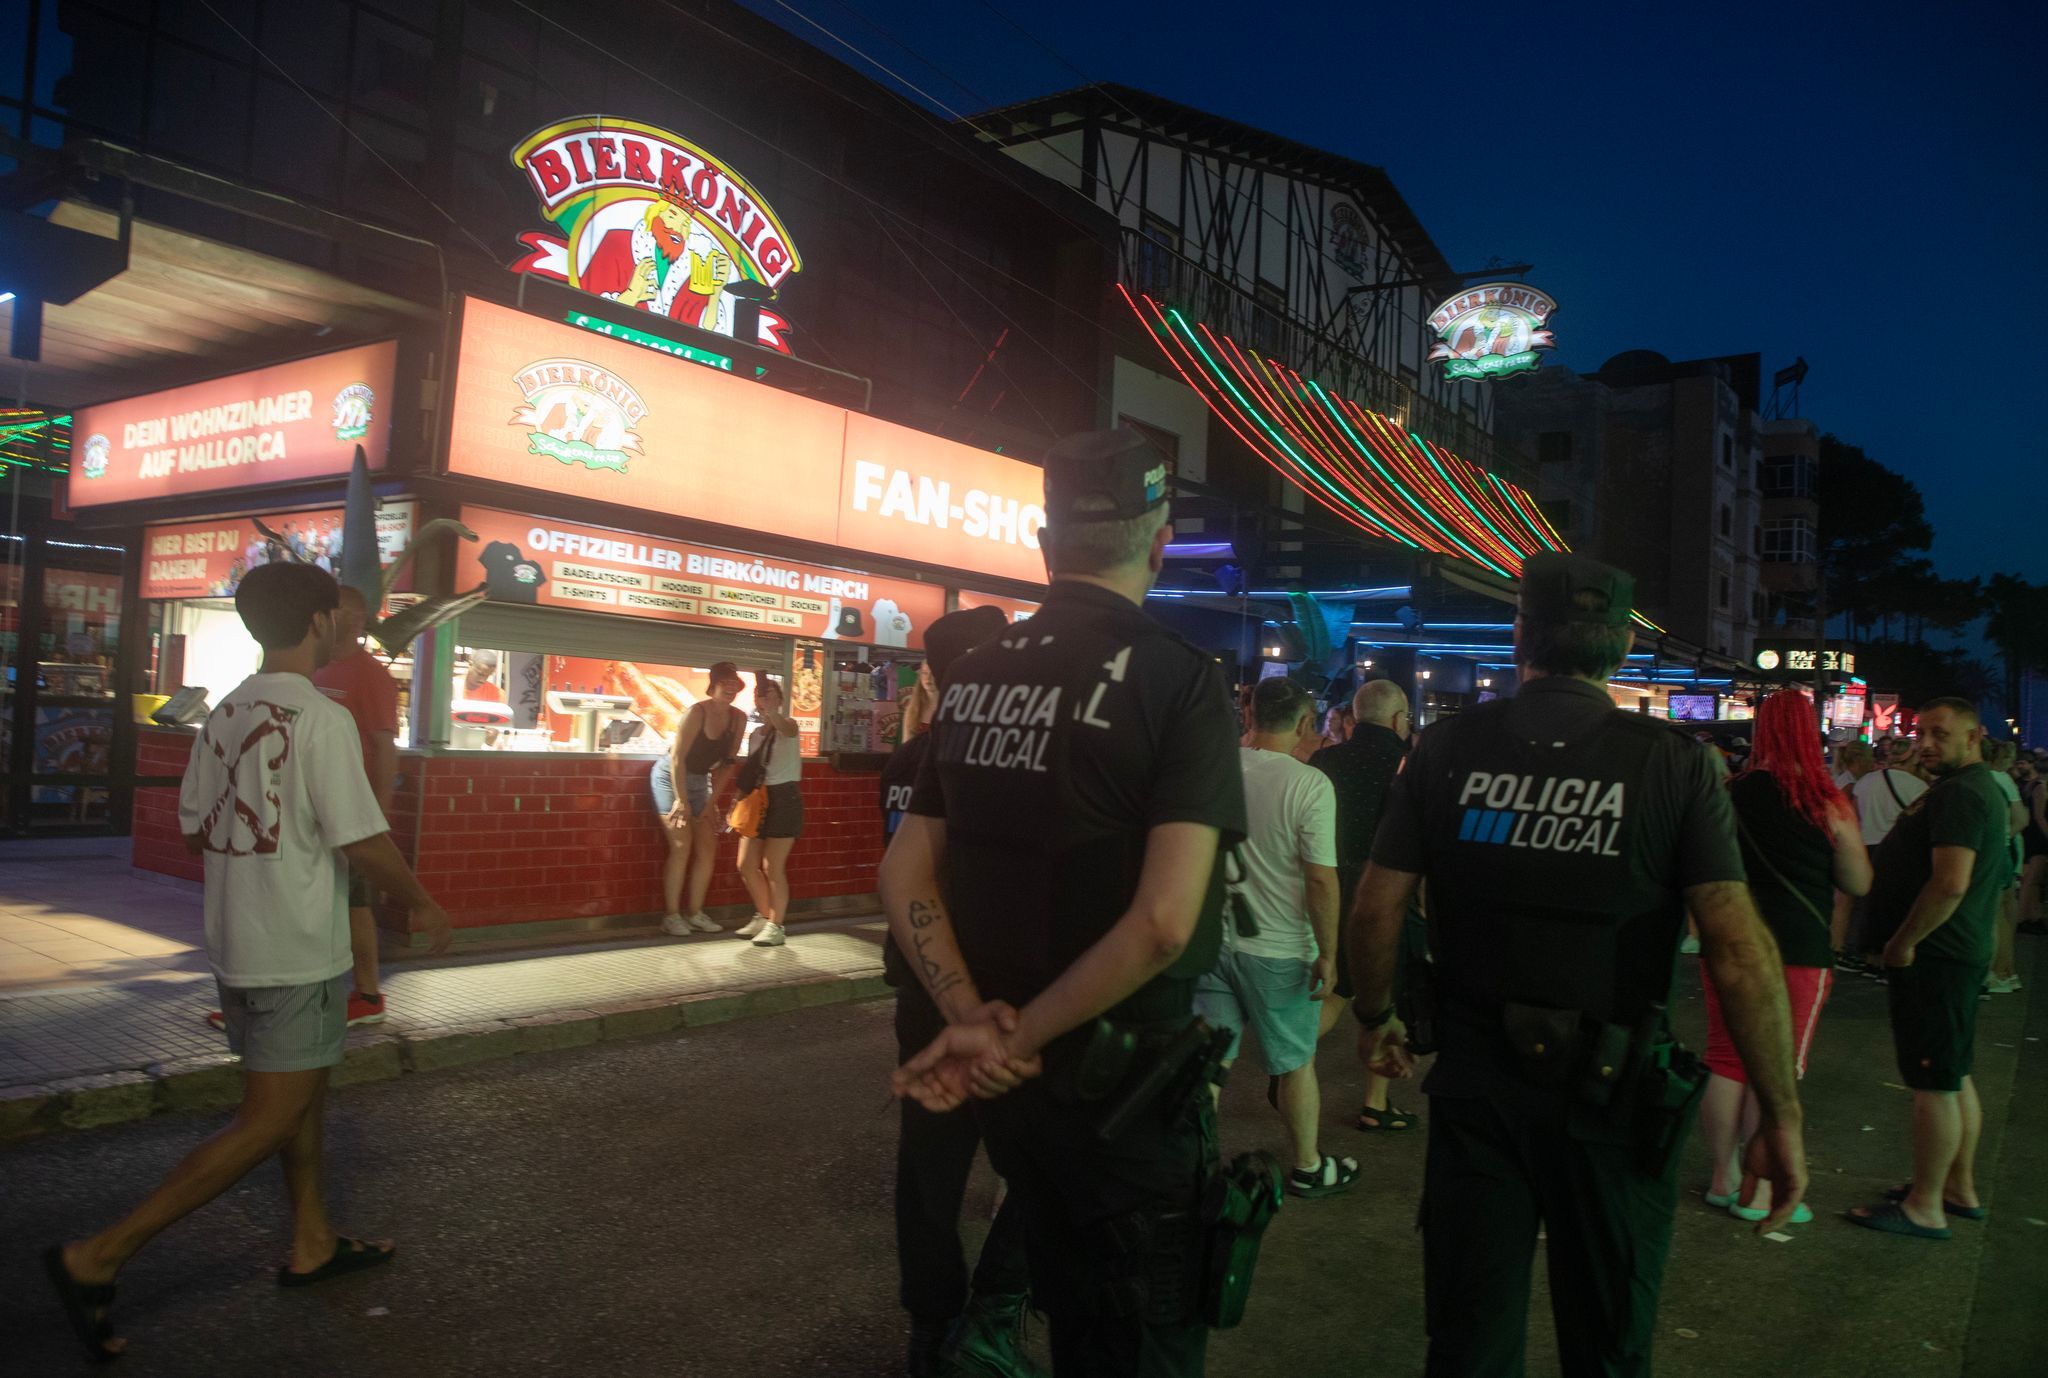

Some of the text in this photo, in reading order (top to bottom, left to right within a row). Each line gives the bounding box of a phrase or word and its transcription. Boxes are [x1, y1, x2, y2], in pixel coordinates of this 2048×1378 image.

[530, 137, 788, 278] BIERKÖNIG
[1432, 286, 1549, 329] BIERKÖNIG
[518, 366, 642, 419] BIERKÖNIG
[123, 420, 168, 450] DEIN
[170, 390, 313, 443] WOHNZIMMER
[138, 431, 286, 479] AUF MALLORCA
[151, 530, 240, 555] HIER BIST DU
[527, 527, 869, 601] OFFIZIELLER BIERKÖNIG MERCH
[562, 567, 823, 613] BADELATSCHEN HOODIES HANDTÜCHER SOCKEN
[562, 586, 607, 601] T-SHIRTS
[628, 593, 692, 611] FISCHERHÜTE
[937, 683, 1062, 727] POLICIA
[965, 726, 1050, 772] LOCAL
[1458, 771, 1625, 819] POLICIA
[1510, 813, 1622, 857] LOCAL
